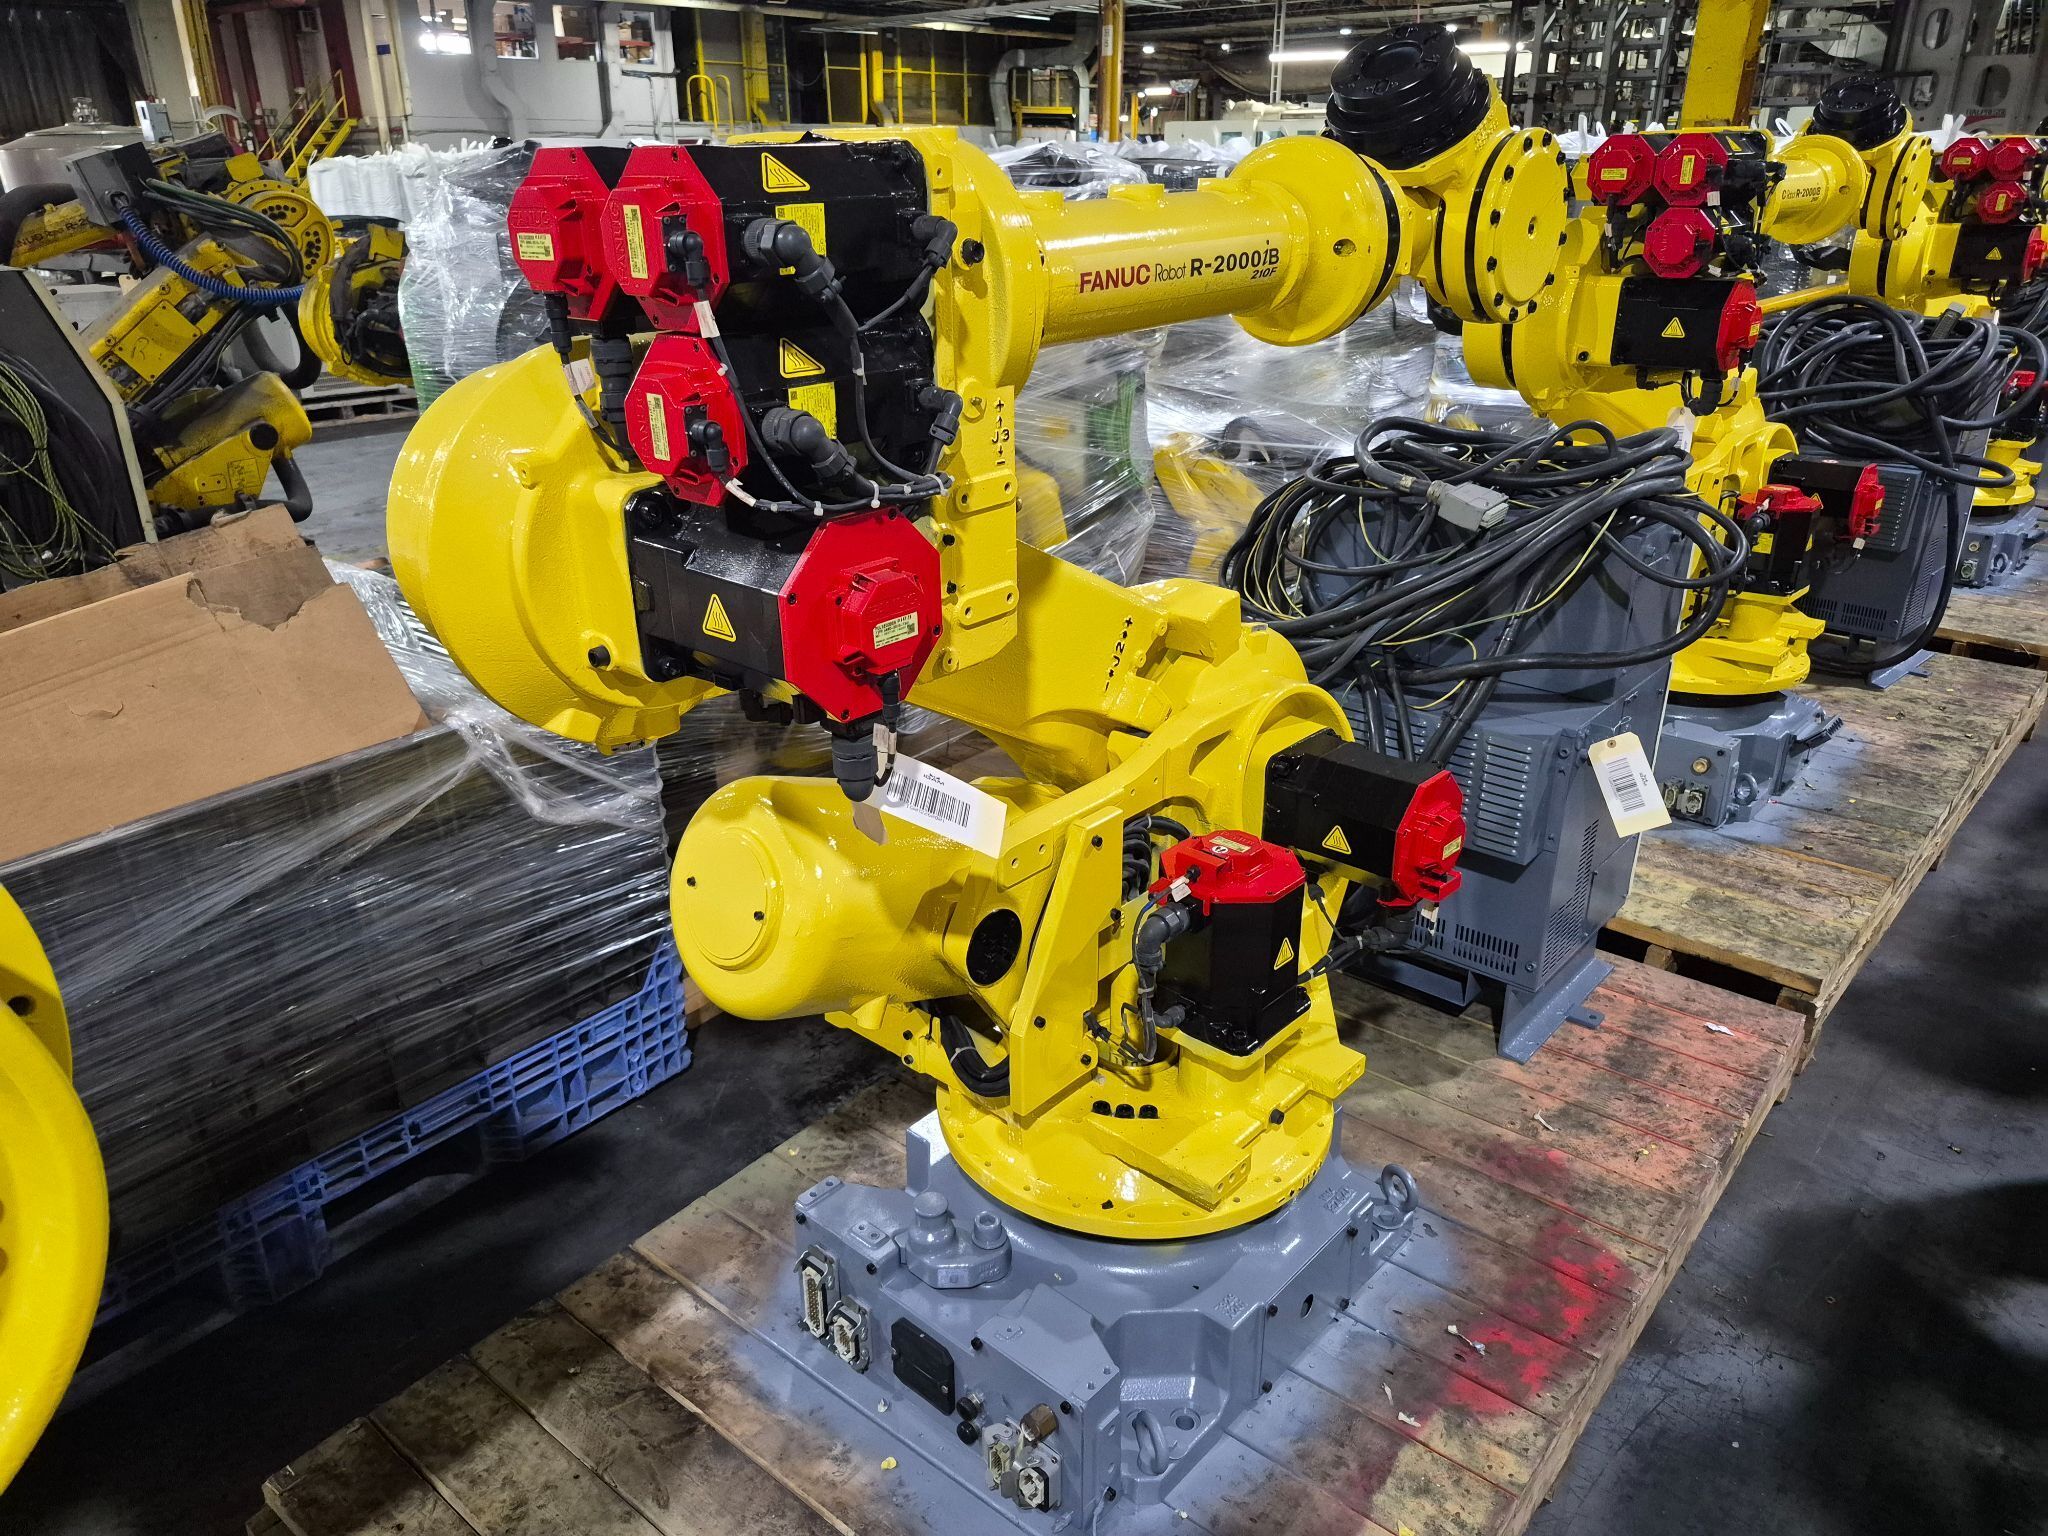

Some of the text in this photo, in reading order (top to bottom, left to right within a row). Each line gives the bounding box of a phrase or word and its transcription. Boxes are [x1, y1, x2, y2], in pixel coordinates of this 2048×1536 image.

[1079, 239, 1280, 293] FANUC Robot R-2000iB
[1250, 266, 1278, 280] 210F
[991, 428, 1010, 444] J3
[1112, 641, 1126, 668] J2
